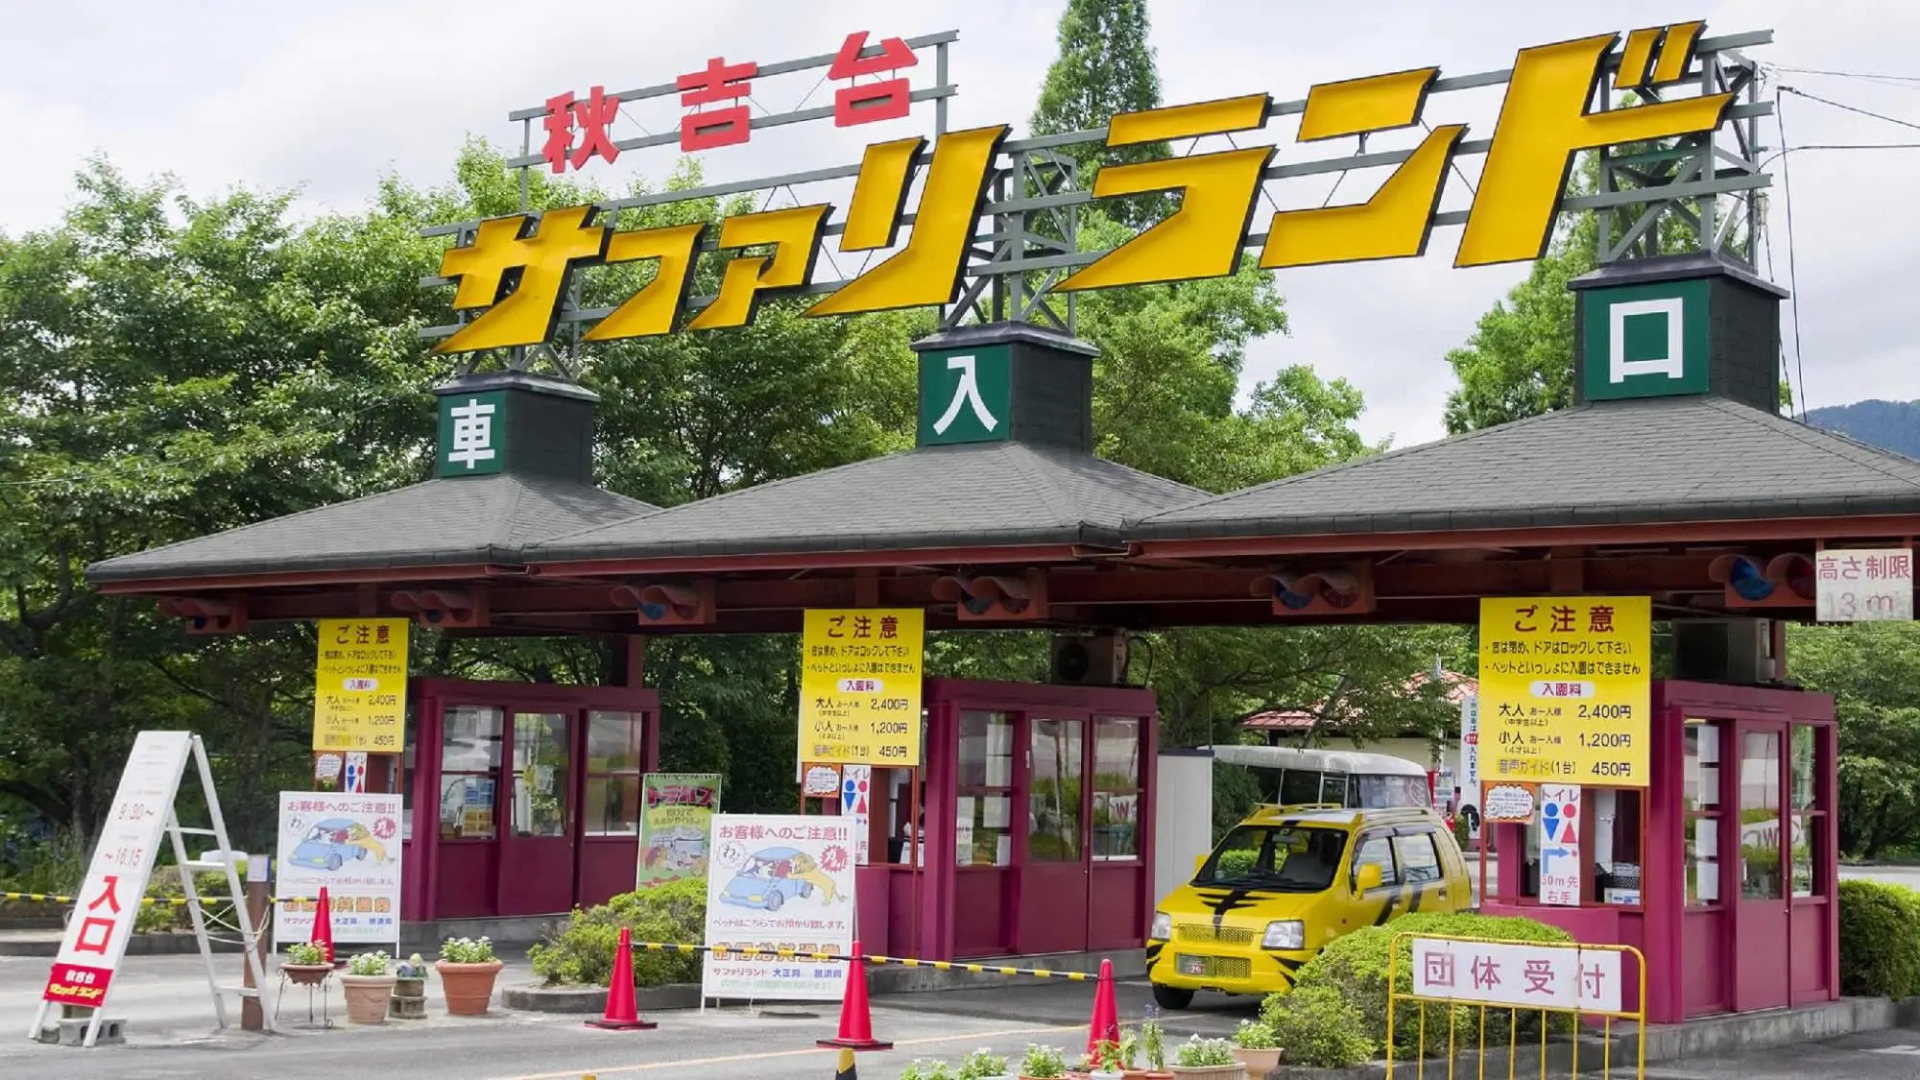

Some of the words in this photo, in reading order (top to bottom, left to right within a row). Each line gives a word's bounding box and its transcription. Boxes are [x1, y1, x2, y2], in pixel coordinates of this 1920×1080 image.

[541, 30, 918, 173] 秋吉台
[433, 20, 1738, 354] サファリランド
[448, 399, 495, 469] 車
[933, 355, 997, 436] 入
[1609, 297, 1683, 384] 口
[1818, 556, 1910, 580] 高さ制限
[828, 616, 898, 639] ご注意
[1515, 605, 1614, 633] ご注意
[336, 624, 390, 645] ご注意
[846, 680, 875, 691] 入園料
[1542, 683, 1581, 696] 入園料
[815, 698, 834, 709] 大人
[871, 699, 908, 711] 2,400円
[1499, 703, 1525, 717] 大人
[1530, 707, 1562, 717] お一人様
[1578, 705, 1632, 720] 2,400円
[815, 721, 833, 732] 小人
[870, 722, 908, 735] 1,200円
[1499, 731, 1524, 744] 小人
[1530, 736, 1562, 744] お一人様
[1578, 733, 1631, 748] 1,200円
[879, 745, 908, 758] 450円
[844, 768, 870, 779] トイレ
[1592, 762, 1631, 776] 450円
[1542, 789, 1579, 801] トイレ
[1547, 890, 1572, 903] 右手
[74, 876, 122, 955] 入口
[713, 967, 768, 977] サファリランド
[1424, 952, 1606, 999] 団体受付
